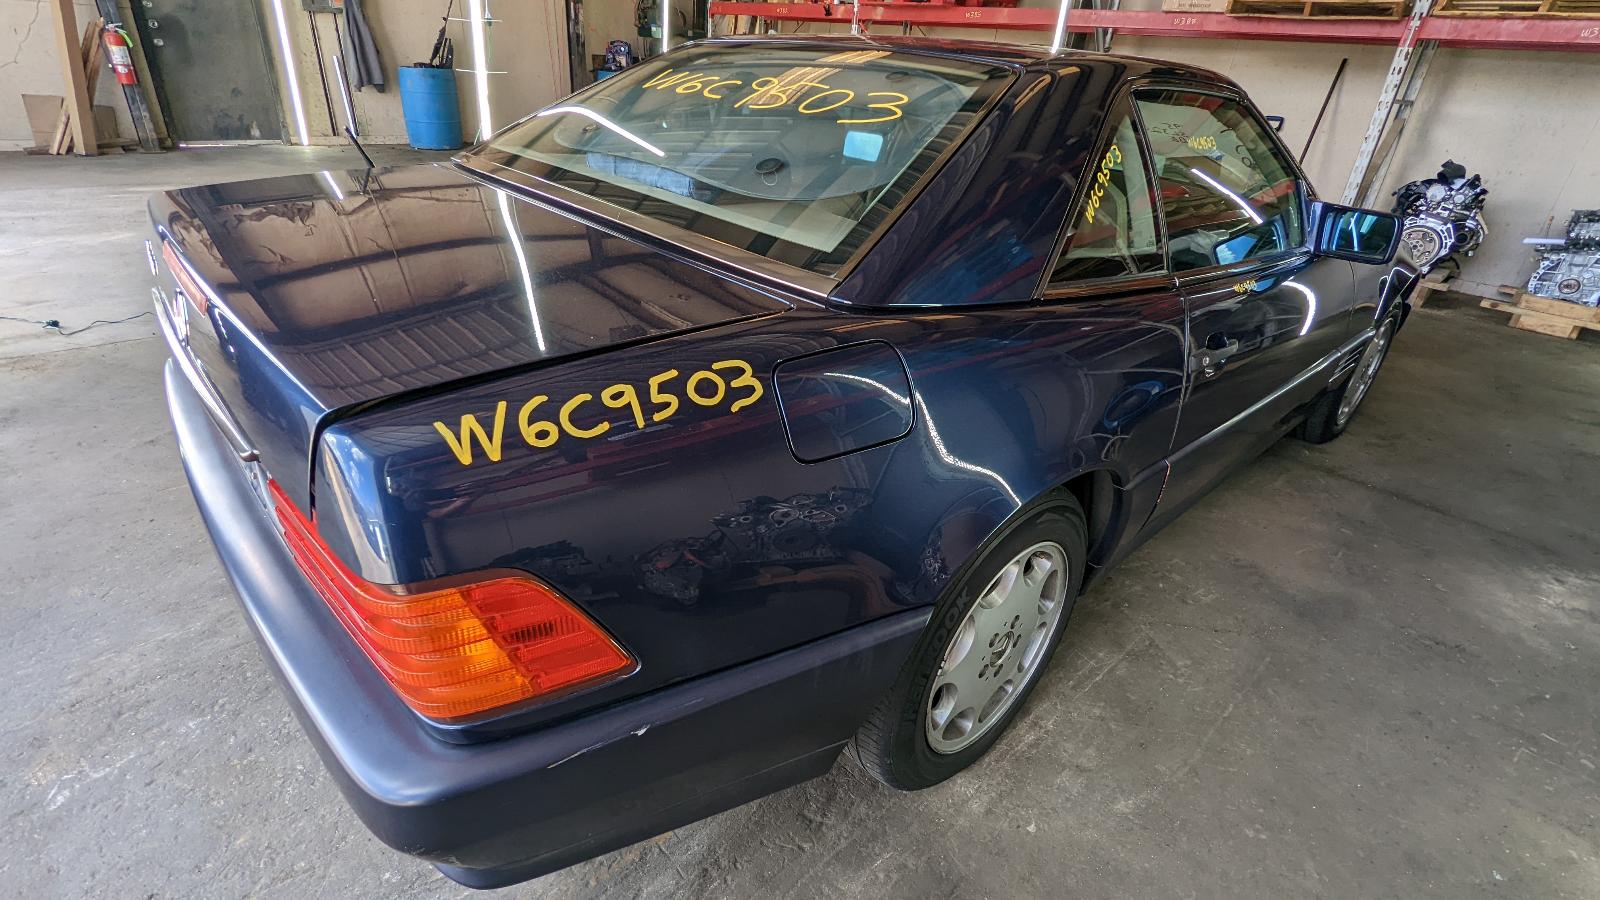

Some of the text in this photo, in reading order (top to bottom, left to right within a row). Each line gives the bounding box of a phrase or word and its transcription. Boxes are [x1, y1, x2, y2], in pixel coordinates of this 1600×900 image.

[642, 68, 909, 124] W6C9503
[1085, 144, 1122, 224] W6C9503
[432, 359, 764, 466] W6C9503
